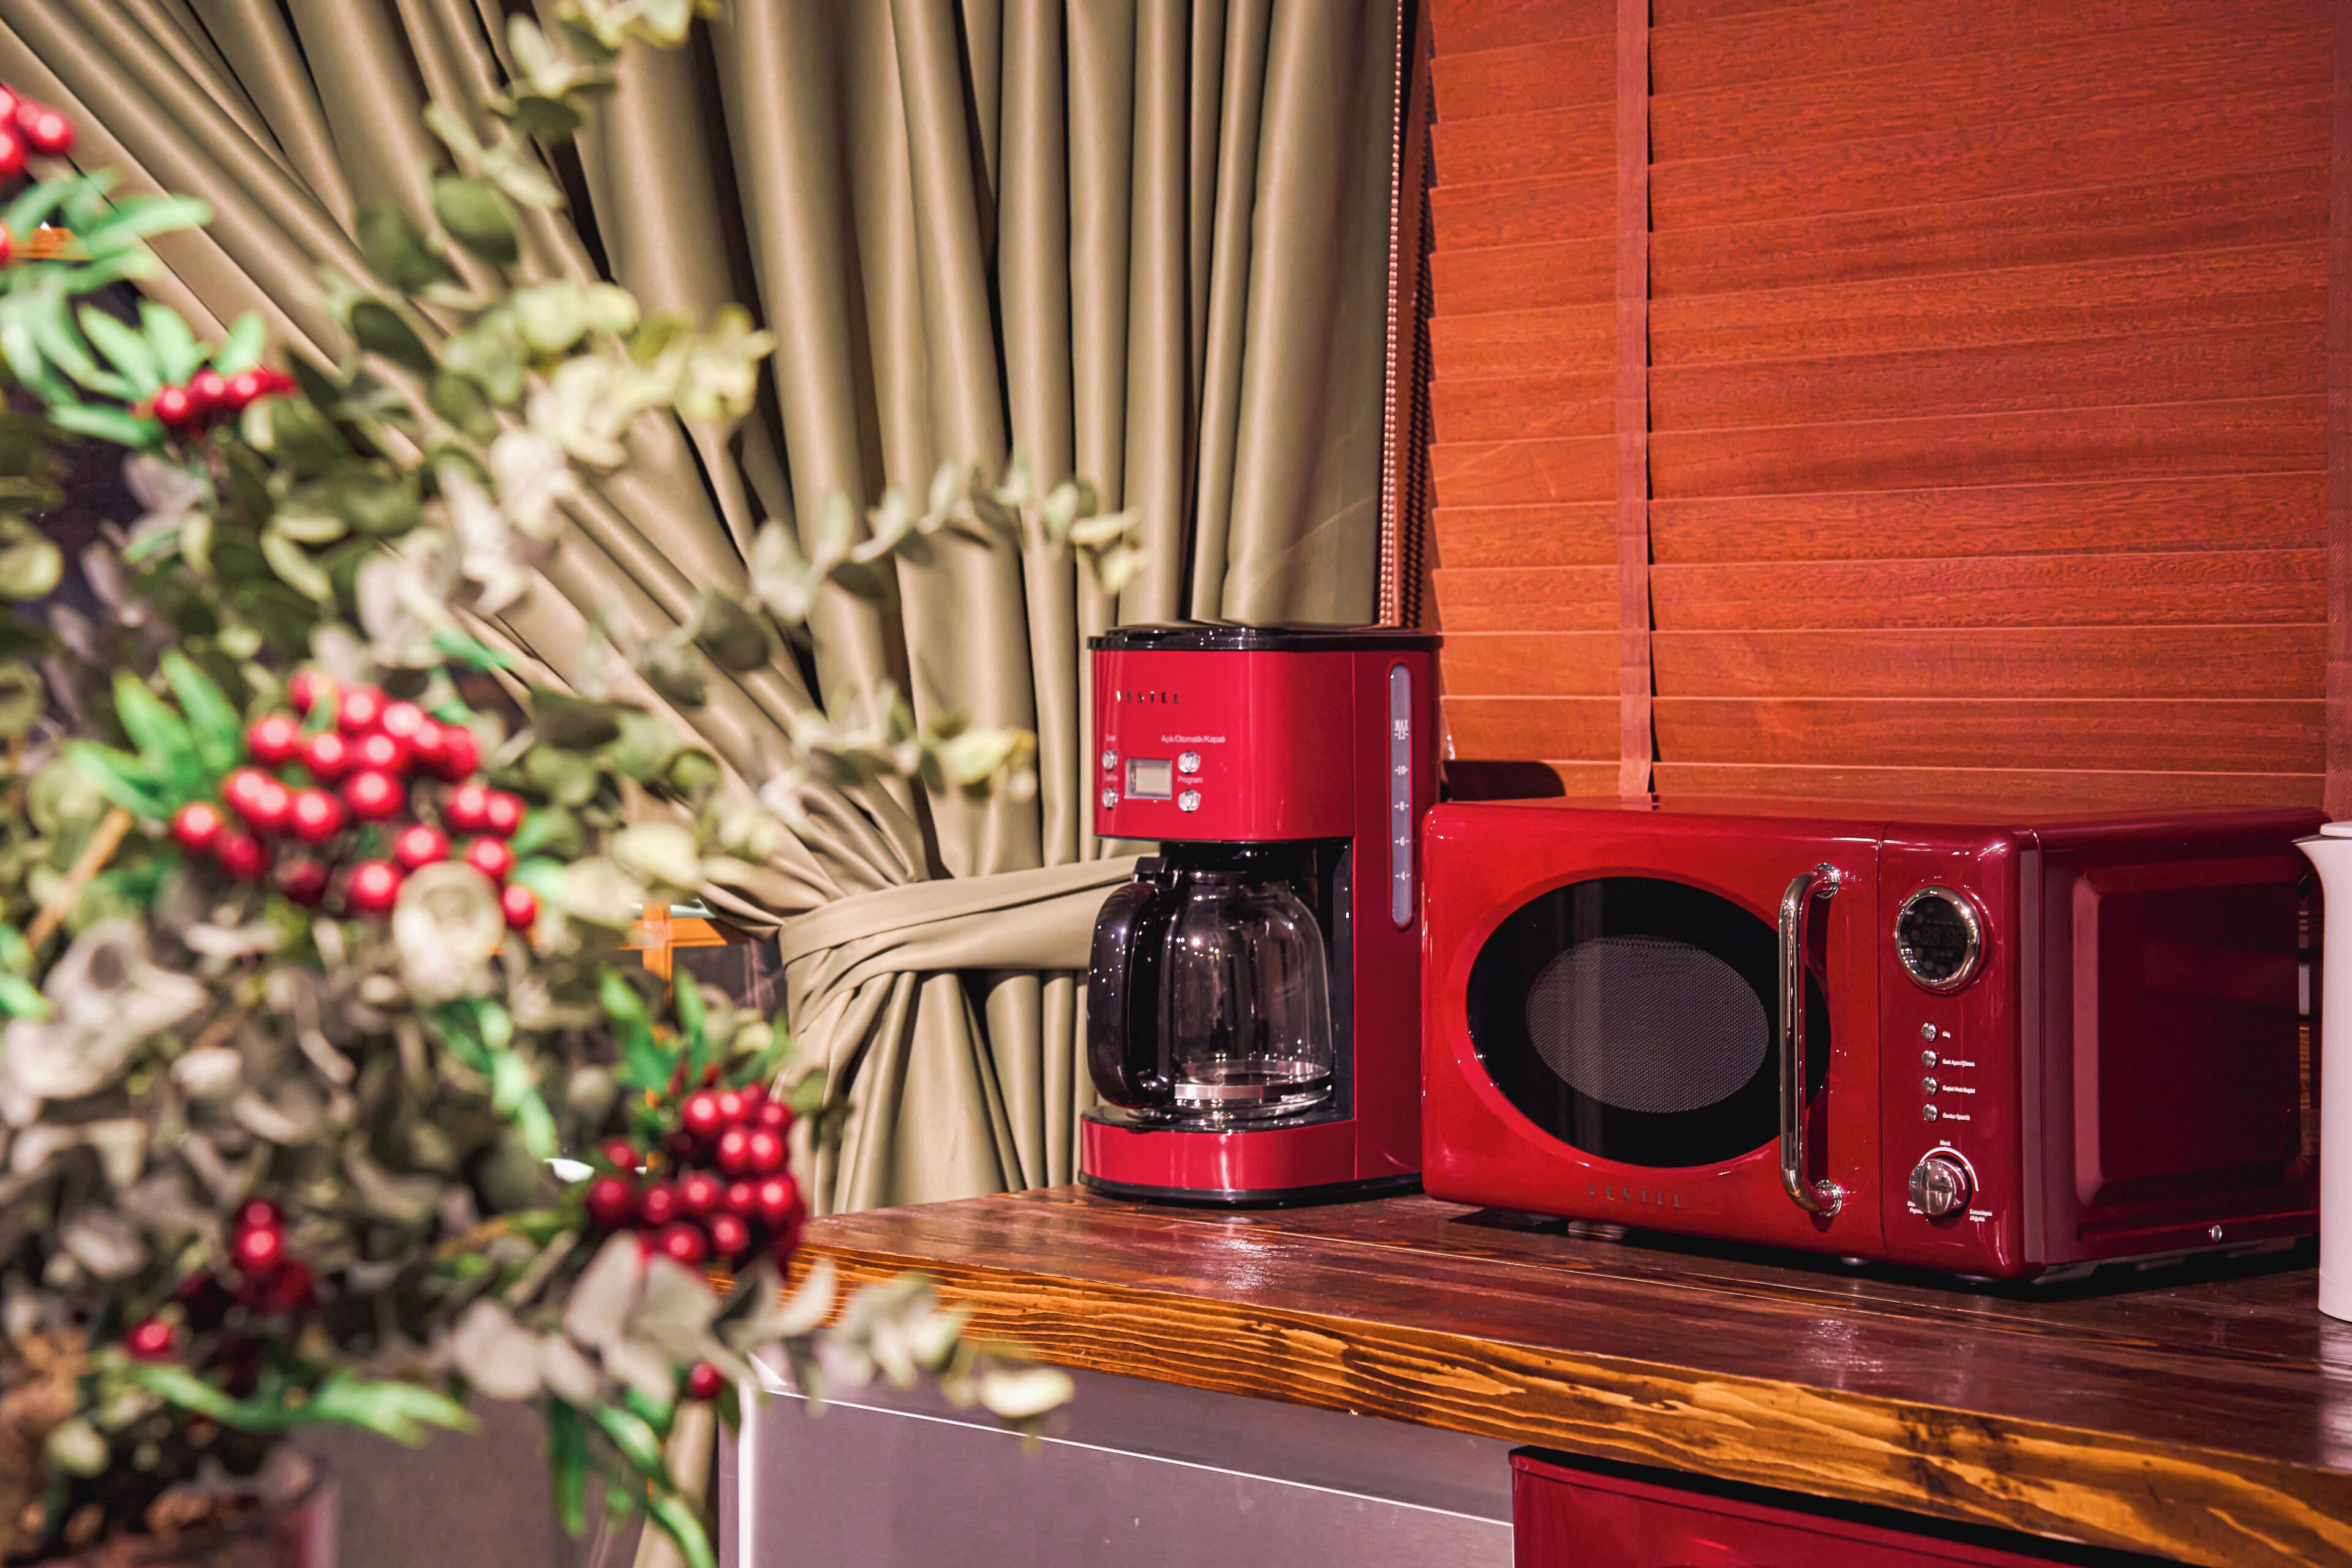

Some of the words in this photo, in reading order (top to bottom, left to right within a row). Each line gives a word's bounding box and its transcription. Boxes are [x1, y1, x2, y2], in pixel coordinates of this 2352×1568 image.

[1394, 719, 1409, 729] MAX
[1177, 775, 1203, 785] Program
[1587, 1183, 1682, 1207] VESTEL
